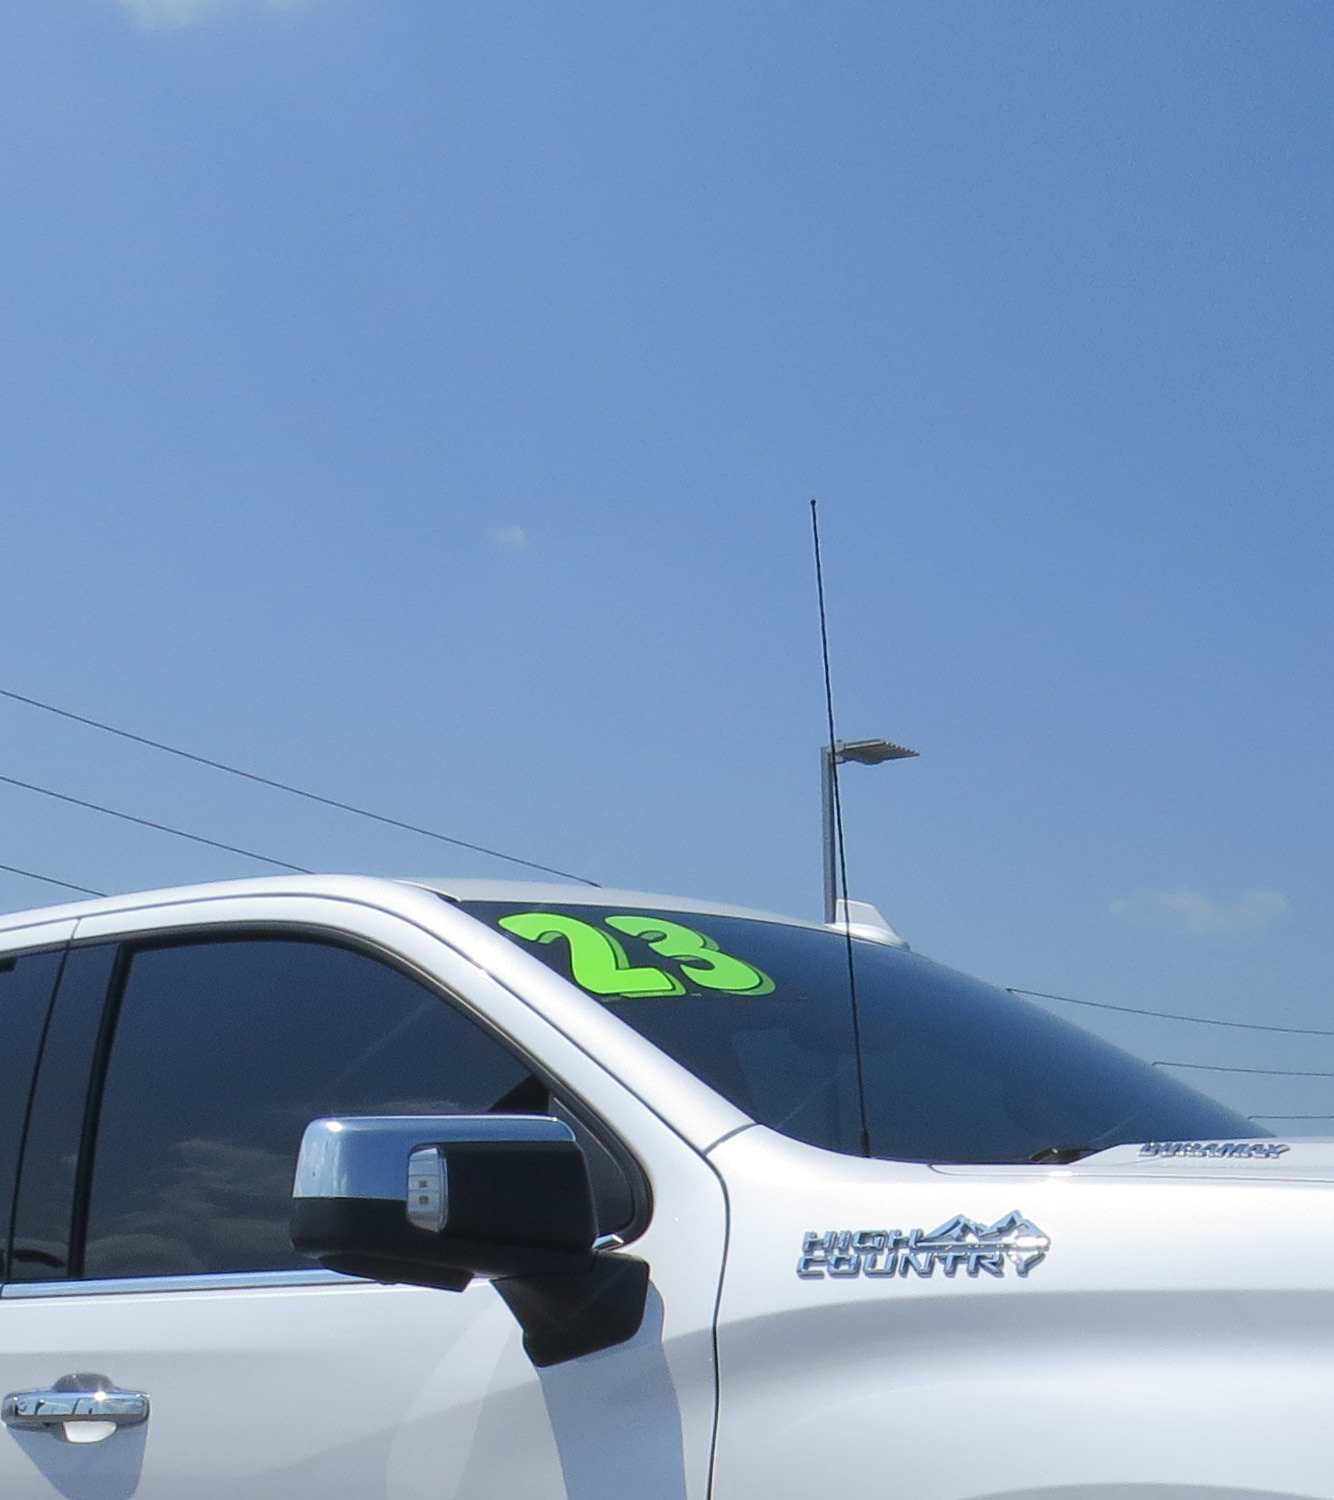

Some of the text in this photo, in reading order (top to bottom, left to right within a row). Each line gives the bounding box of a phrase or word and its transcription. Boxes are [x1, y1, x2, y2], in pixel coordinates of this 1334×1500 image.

[498, 912, 774, 997] 23
[802, 1229, 924, 1251] HIGH
[796, 1250, 1047, 1278] COUNTRY
